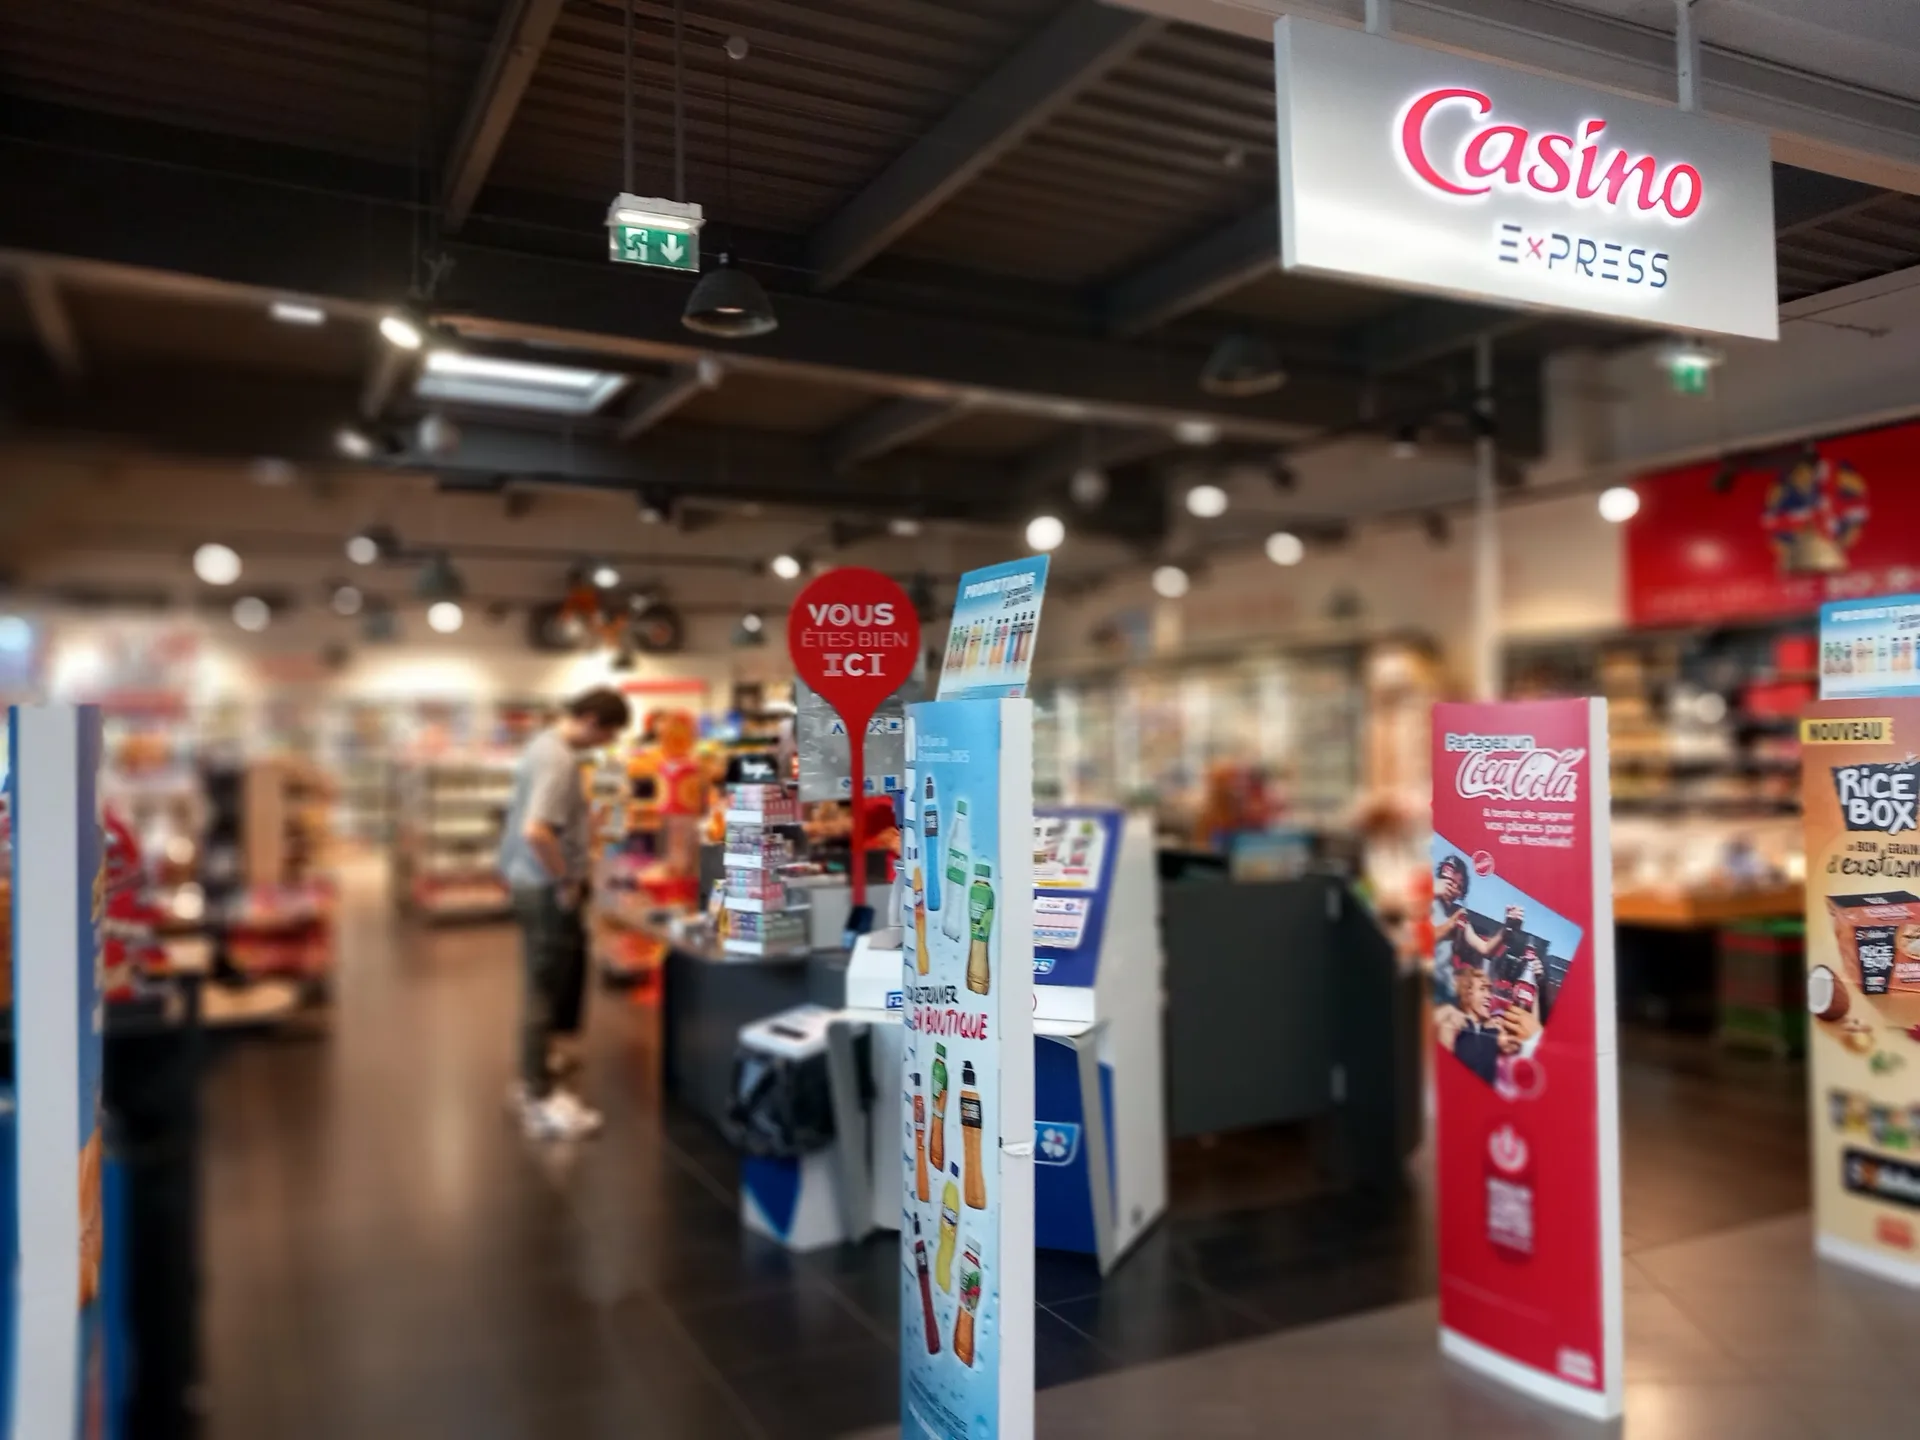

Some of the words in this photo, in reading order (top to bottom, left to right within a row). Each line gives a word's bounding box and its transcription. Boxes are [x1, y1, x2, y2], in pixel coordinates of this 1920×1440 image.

[1400, 88, 1704, 220] Casino
[807, 602, 895, 627] VOUS
[801, 628, 855, 648] ÊTES
[858, 632, 909, 648] BIEN
[822, 652, 886, 678] ICI
[1445, 733, 1509, 752] Partagez
[1511, 735, 1535, 749] un
[1808, 721, 1883, 741] NOUVEAU
[1848, 798, 1917, 836] BOX
